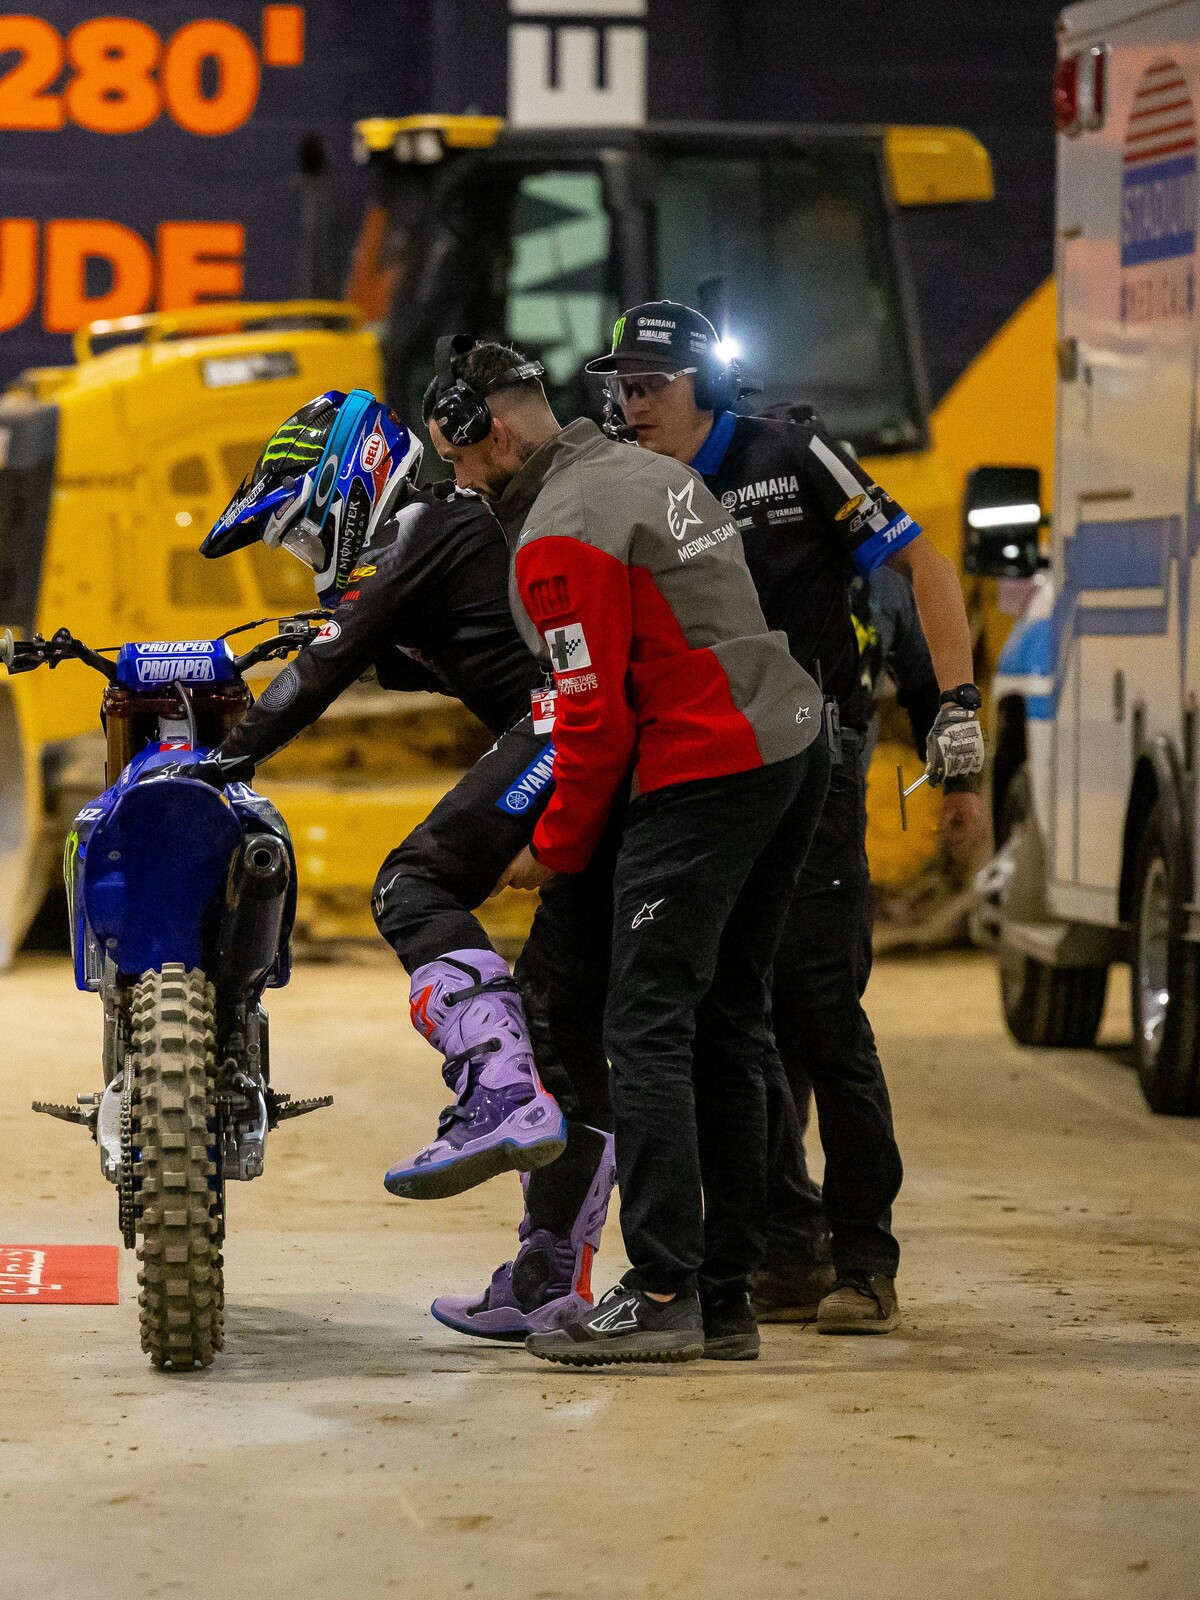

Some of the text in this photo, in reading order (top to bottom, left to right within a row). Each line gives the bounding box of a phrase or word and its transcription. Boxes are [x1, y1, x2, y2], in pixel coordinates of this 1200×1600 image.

[646, 318, 676, 329] YAMAHA
[364, 440, 381, 466] BELL
[737, 475, 799, 503] YAMAHA
[727, 493, 797, 513] RACING
[677, 521, 738, 562] MEDICAL TEAM
[140, 643, 208, 653] PROTAPER
[141, 659, 211, 681] PROTAPER
[74, 808, 106, 821] YZ
